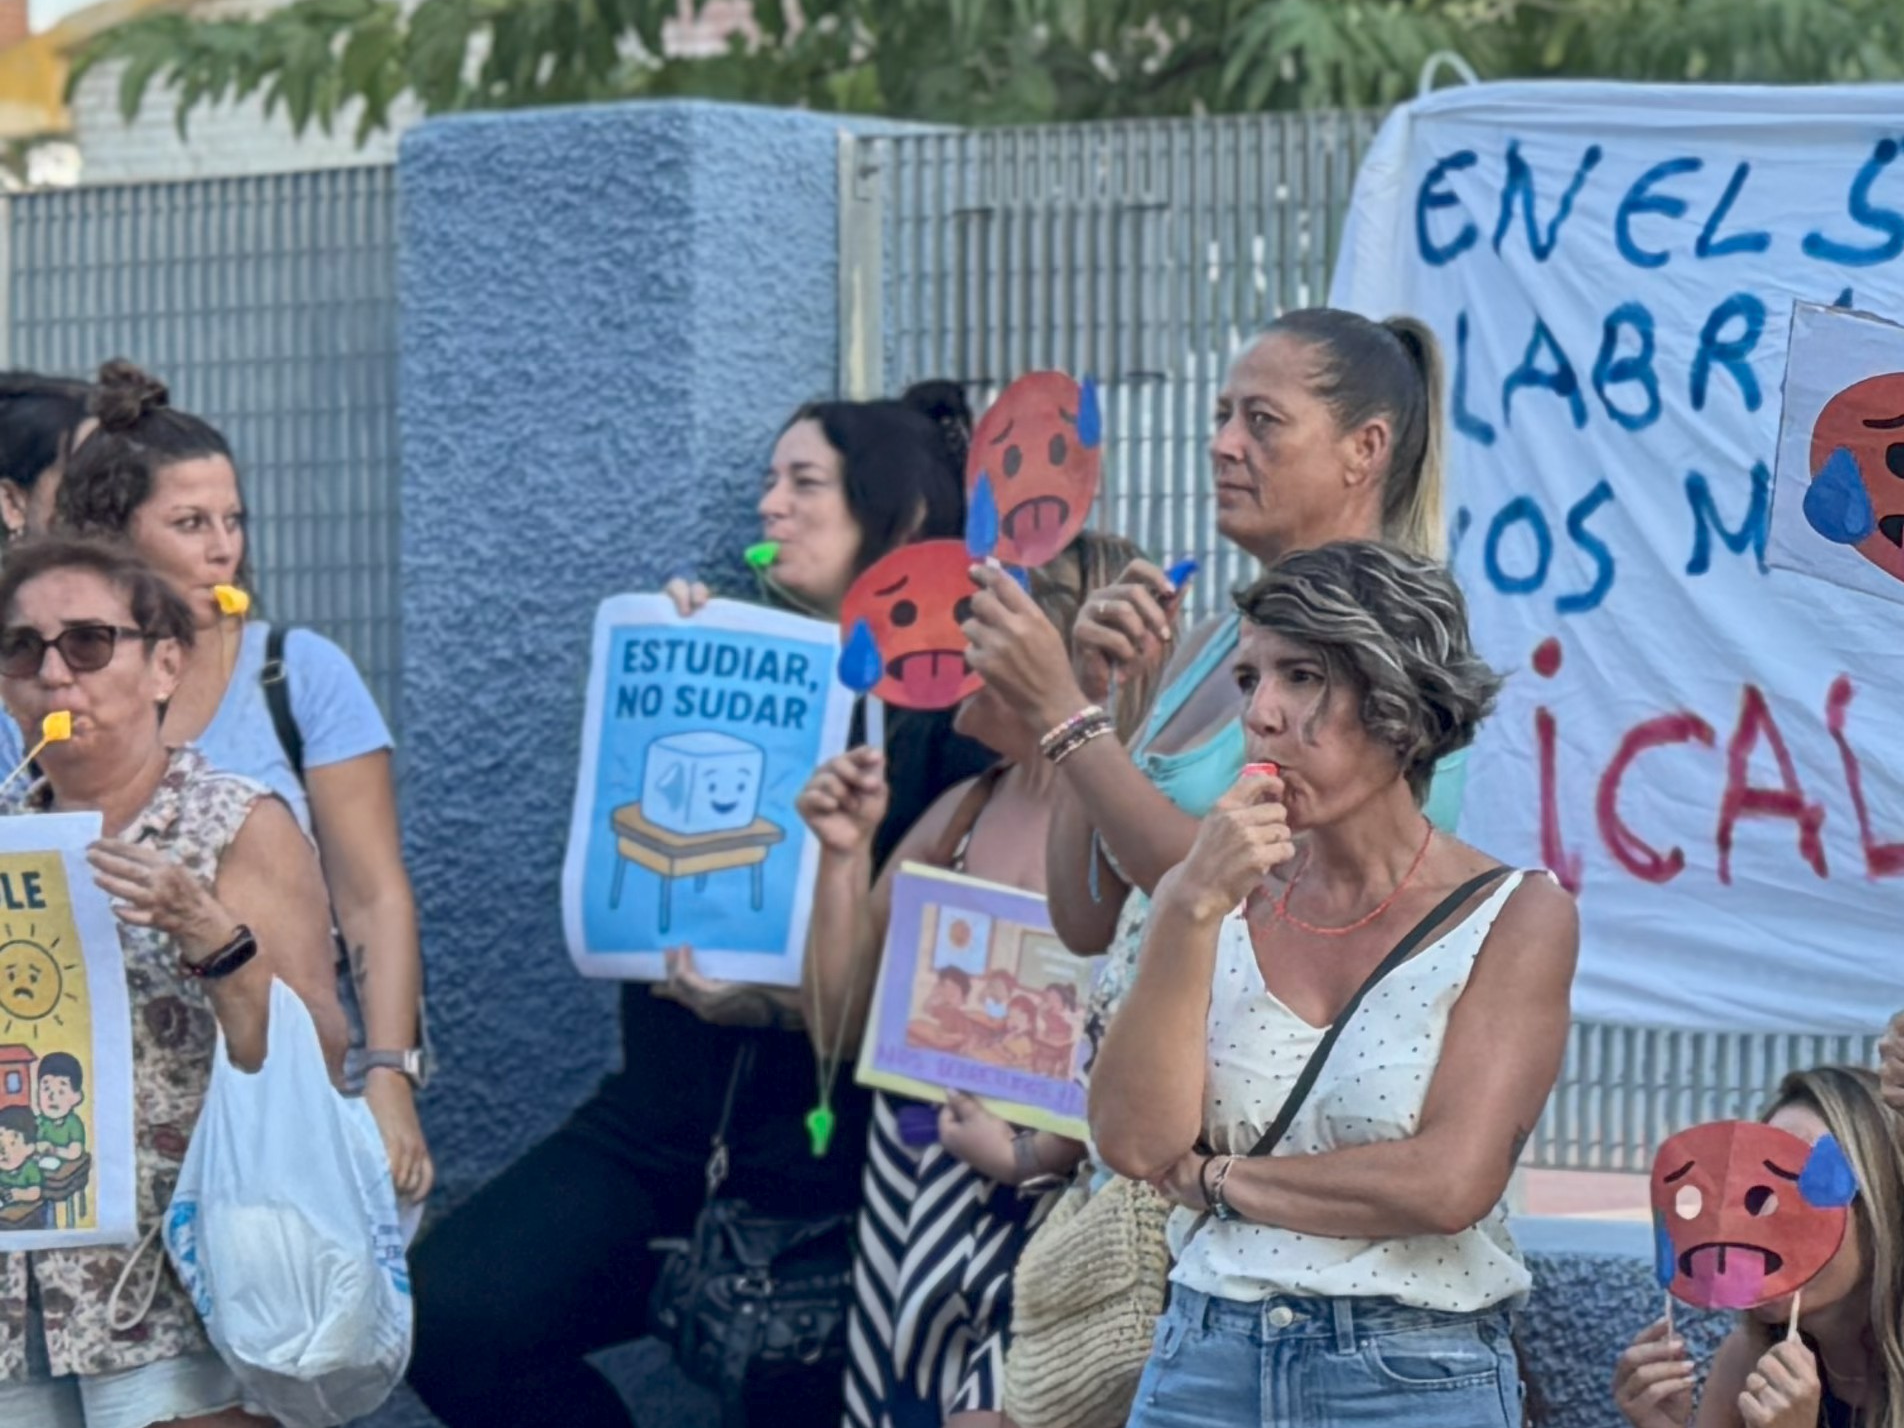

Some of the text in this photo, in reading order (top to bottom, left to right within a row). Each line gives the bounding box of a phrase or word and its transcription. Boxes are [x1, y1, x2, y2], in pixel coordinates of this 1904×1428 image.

[1414, 137, 1604, 266] EN
[1613, 154, 1771, 269] EL
[1448, 477, 1615, 614] OS
[622, 637, 818, 694] ESTUDIAR,
[615, 682, 808, 730] NO SUDAR
[0, 870, 47, 910] LE
